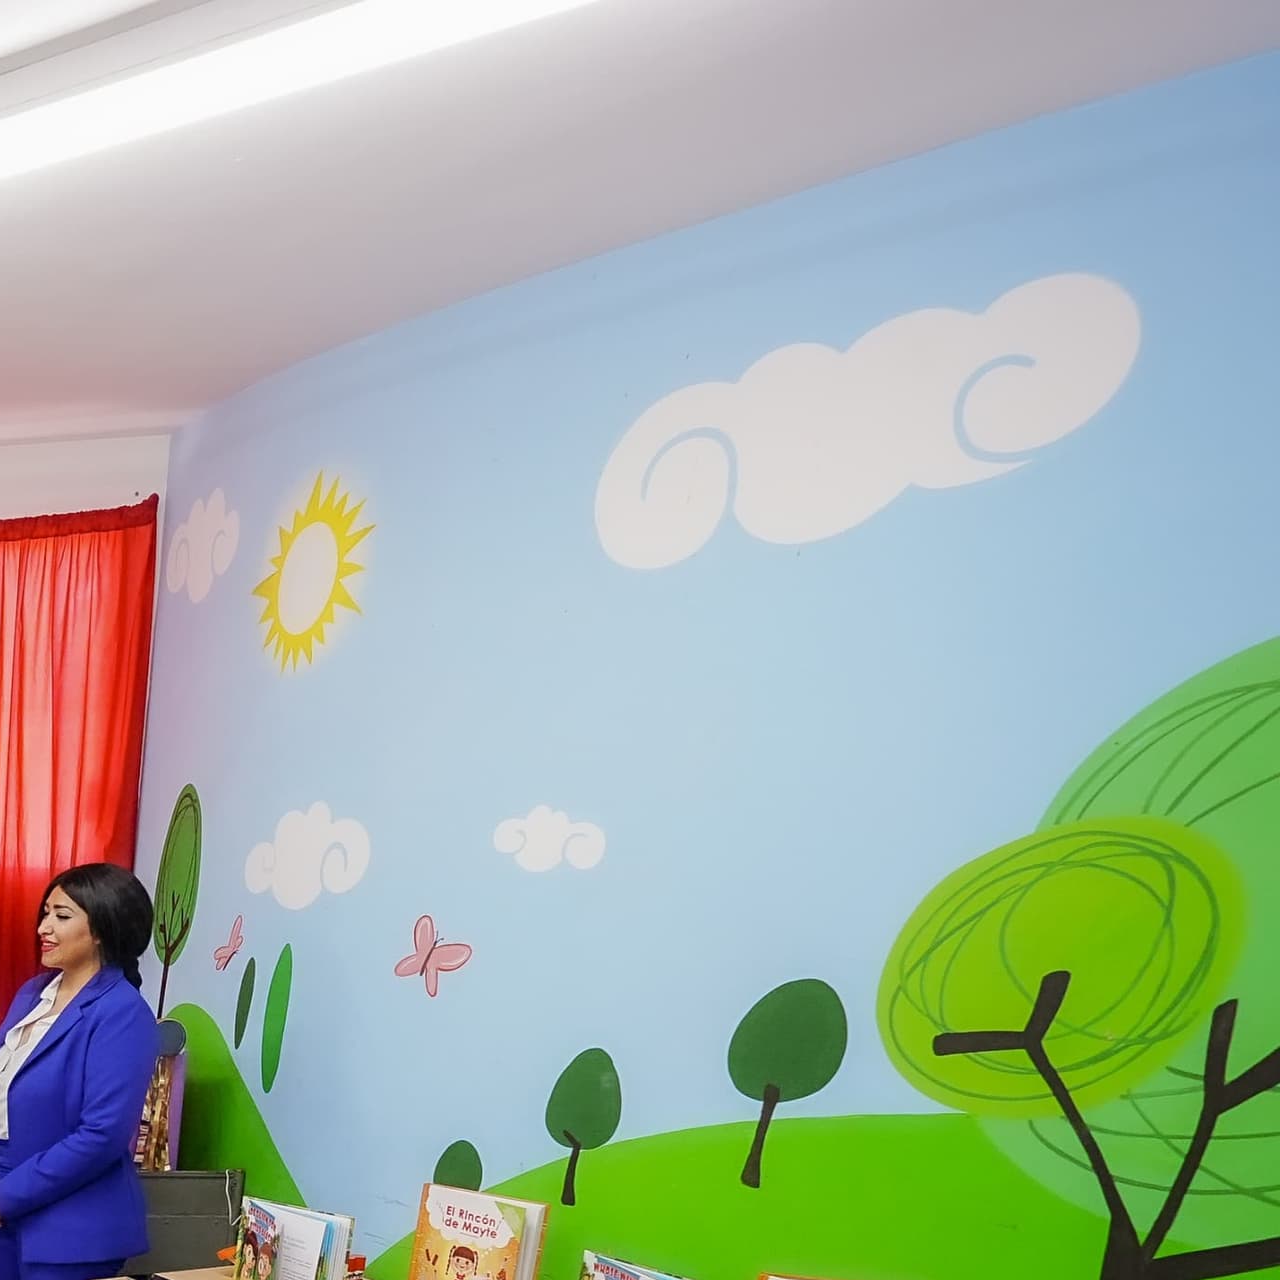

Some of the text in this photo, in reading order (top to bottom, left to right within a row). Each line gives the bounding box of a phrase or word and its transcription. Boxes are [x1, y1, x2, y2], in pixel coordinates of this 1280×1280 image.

[444, 1217, 498, 1239] de Mayte
[446, 1206, 496, 1228] El Rincón
